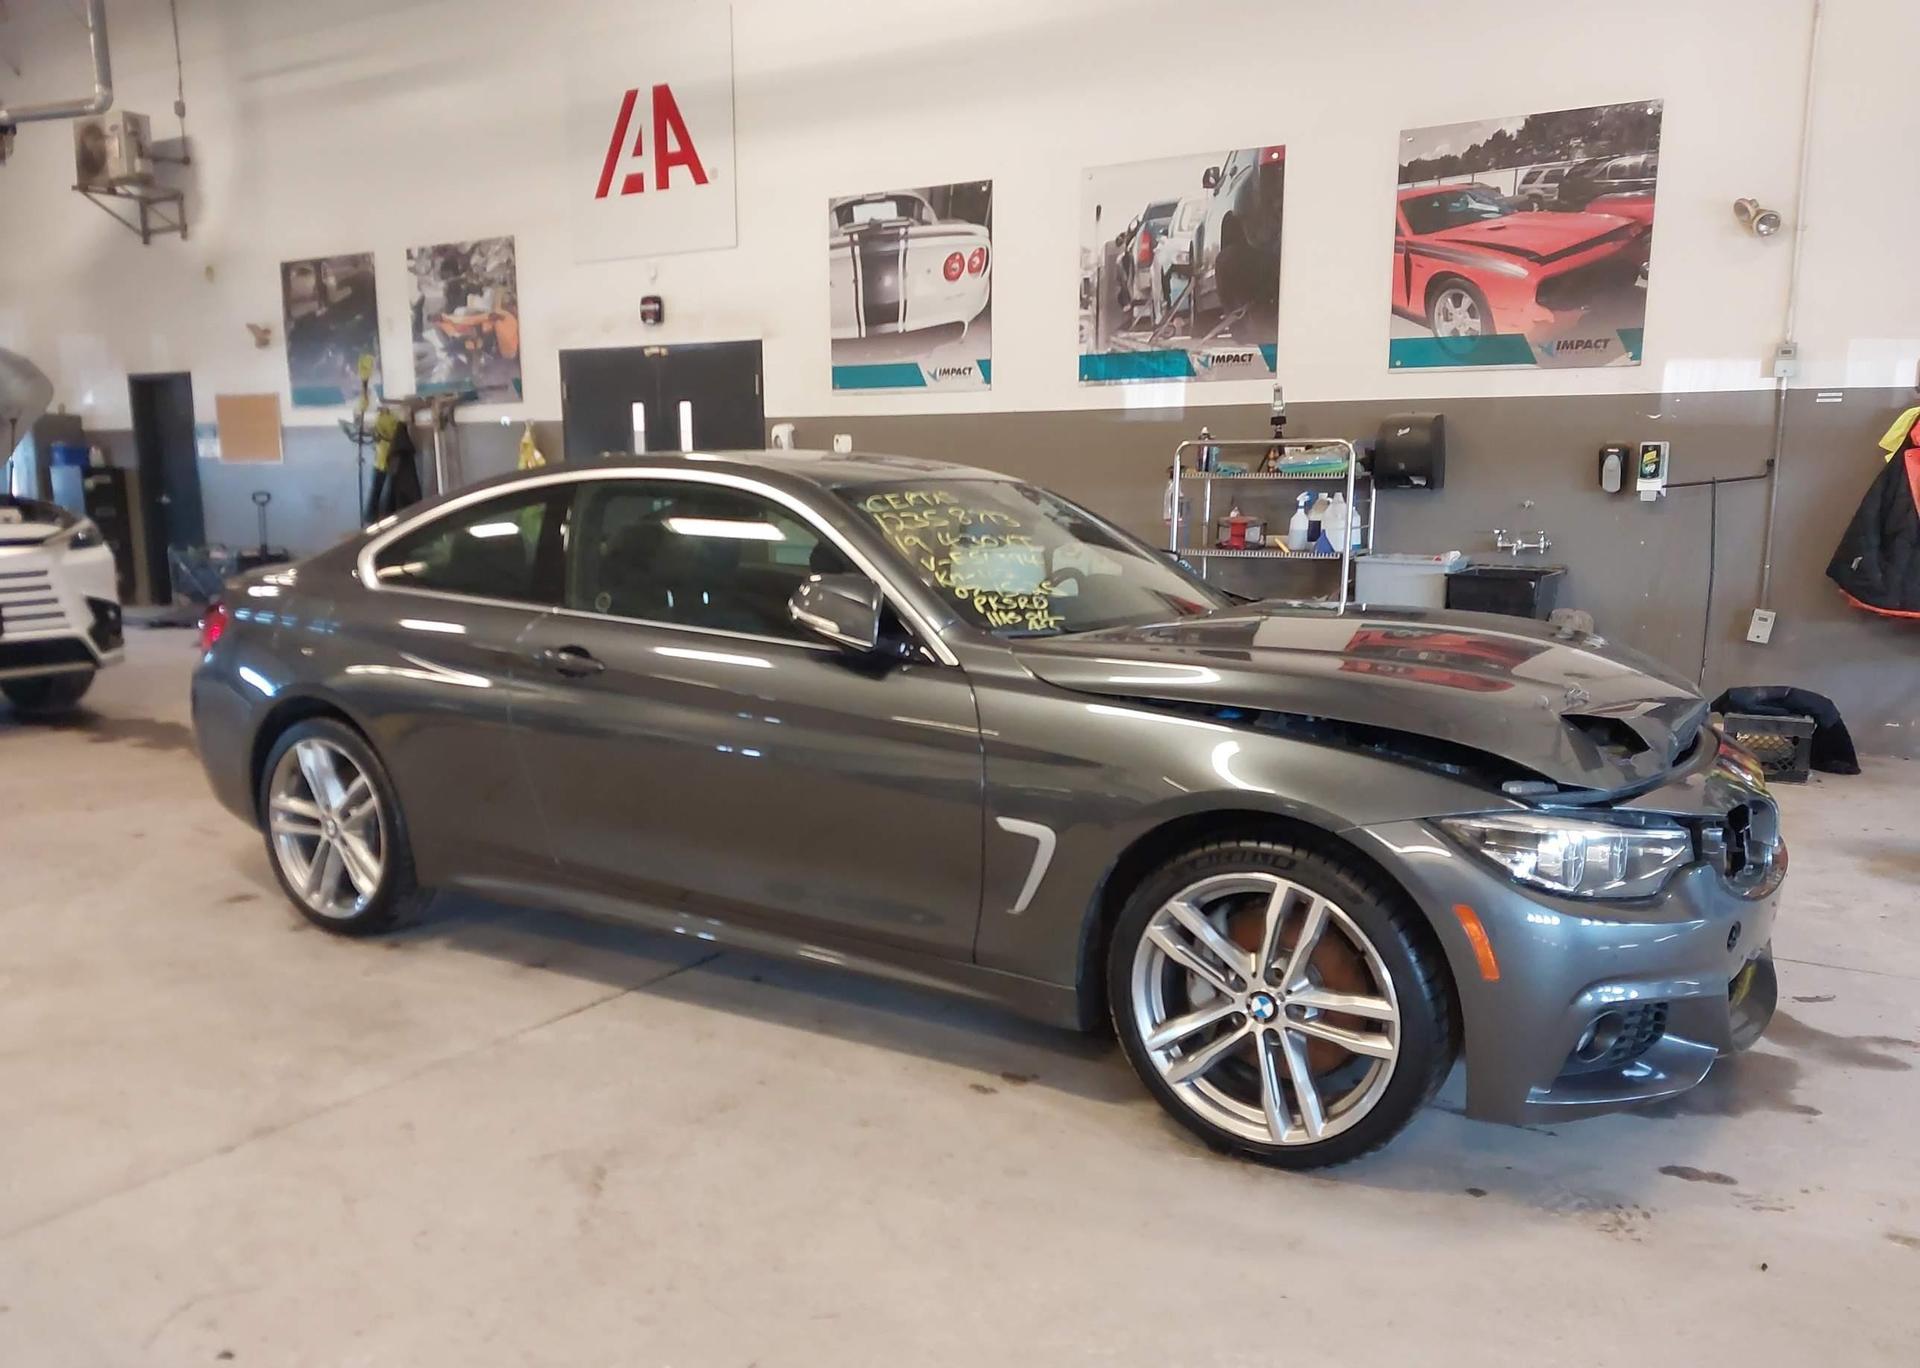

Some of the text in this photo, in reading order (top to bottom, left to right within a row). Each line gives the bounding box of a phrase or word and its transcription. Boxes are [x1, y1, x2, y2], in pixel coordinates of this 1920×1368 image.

[1556, 338, 1609, 351] IMPACT
[1212, 353, 1253, 364] IMPACT
[939, 367, 972, 377] IMPACT
